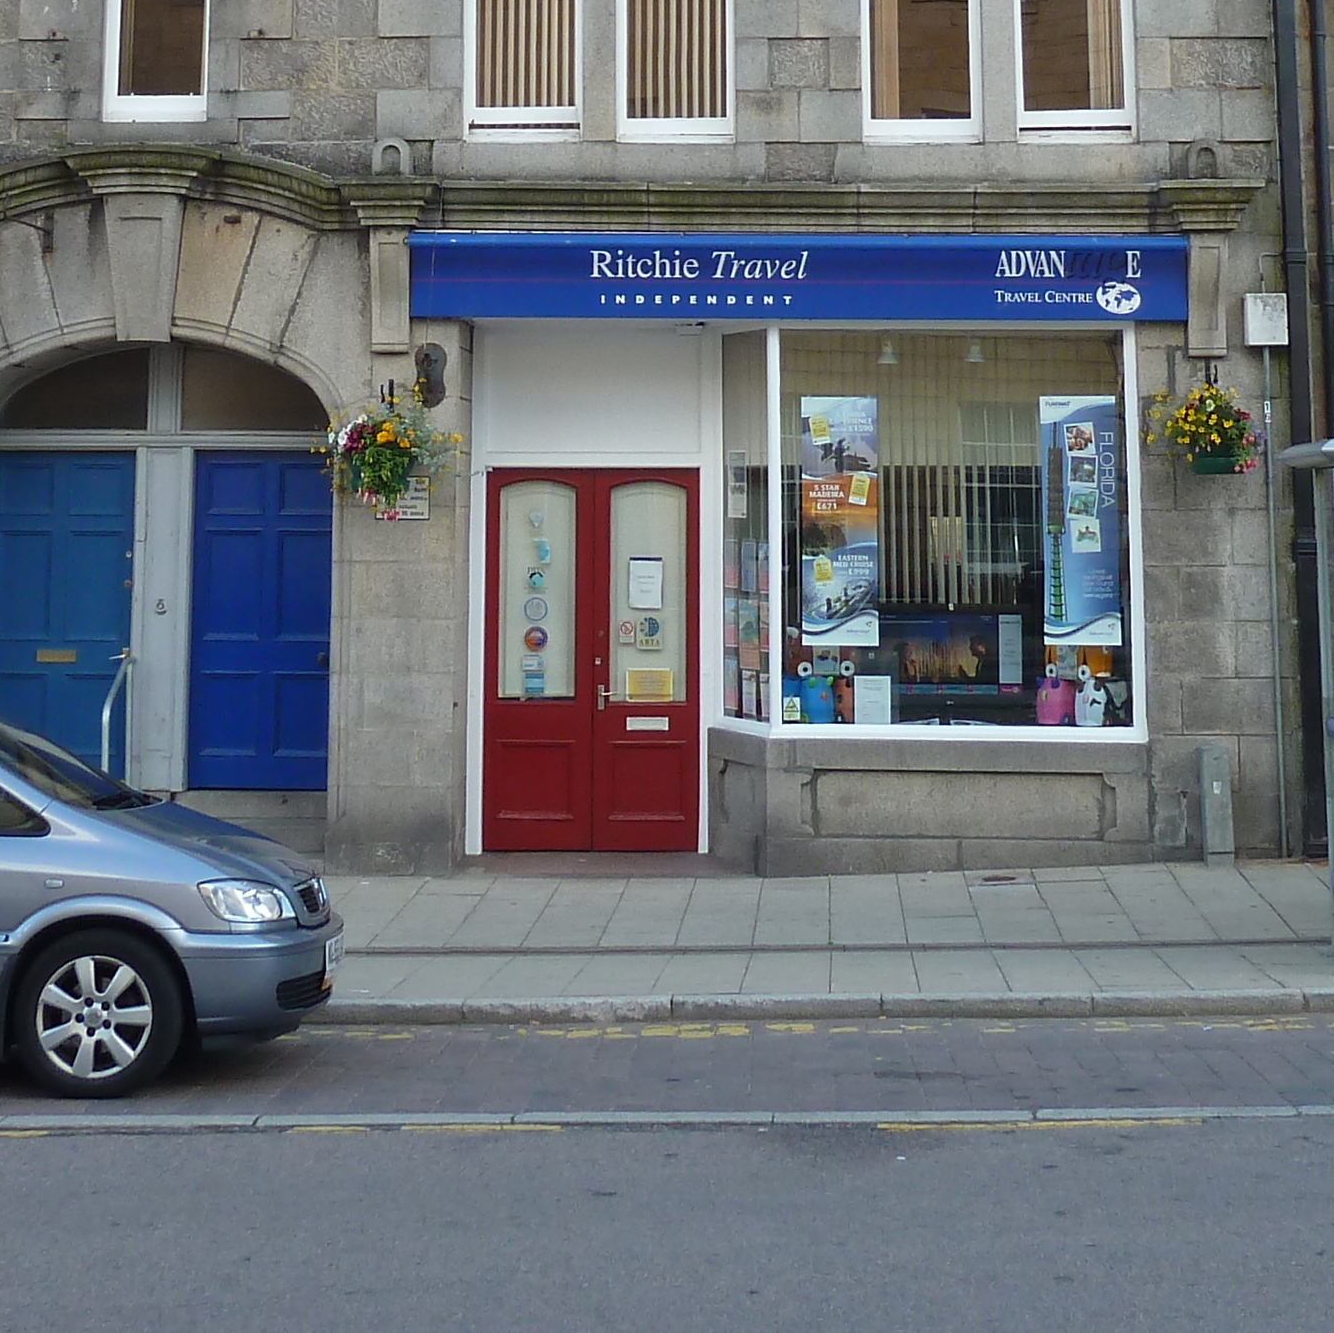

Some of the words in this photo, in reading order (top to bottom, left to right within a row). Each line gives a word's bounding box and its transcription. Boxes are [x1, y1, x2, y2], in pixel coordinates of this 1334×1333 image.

[589, 250, 701, 279] Ritchie
[711, 250, 809, 280] Travel
[599, 294, 793, 305] INDEPENDENT
[994, 290, 1042, 303] TRAVEL
[1044, 290, 1094, 303] CENTRE
[1099, 431, 1116, 508] FLORIDA
[816, 502, 838, 510] £671
[837, 554, 869, 562] EASTERN
